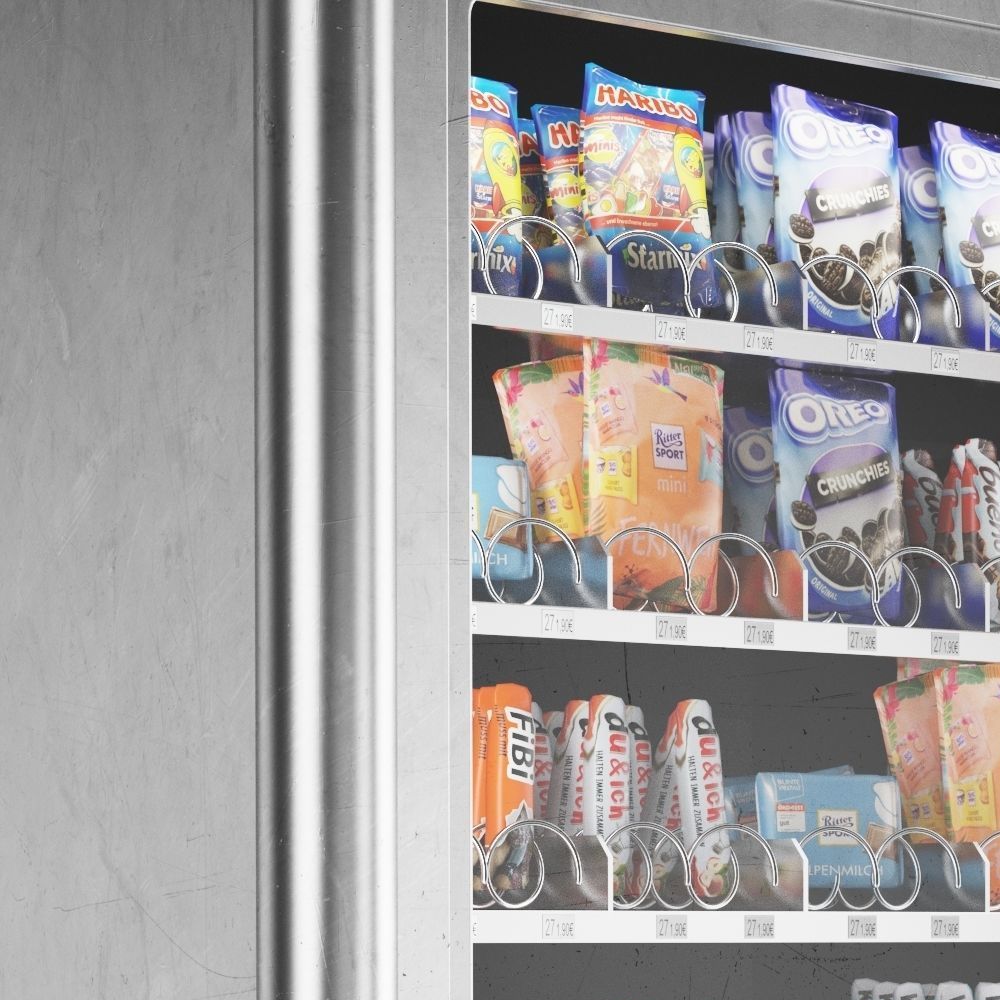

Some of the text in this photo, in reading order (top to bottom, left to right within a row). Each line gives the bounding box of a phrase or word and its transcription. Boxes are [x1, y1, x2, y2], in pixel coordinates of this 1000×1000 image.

[594, 83, 698, 124] HARIBO
[787, 111, 888, 150] OREO
[815, 184, 890, 213] CRUNCHIES
[807, 290, 833, 319] ORIGINAL
[658, 321, 668, 338] 27
[747, 331, 755, 347] 27
[934, 352, 942, 368] 27
[787, 396, 886, 434] OREO
[654, 429, 683, 449] Ritter
[655, 448, 684, 460] SPORT
[657, 477, 687, 494] mini
[816, 461, 890, 496] CRUNCHIES
[810, 578, 837, 600] ORIGINAL
[659, 621, 668, 637] 27
[747, 626, 756, 642] 27
[609, 758, 629, 776] &
[702, 761, 721, 780] &
[546, 919, 555, 936] 27
[660, 919, 668, 936] 27
[748, 920, 756, 936] 27
